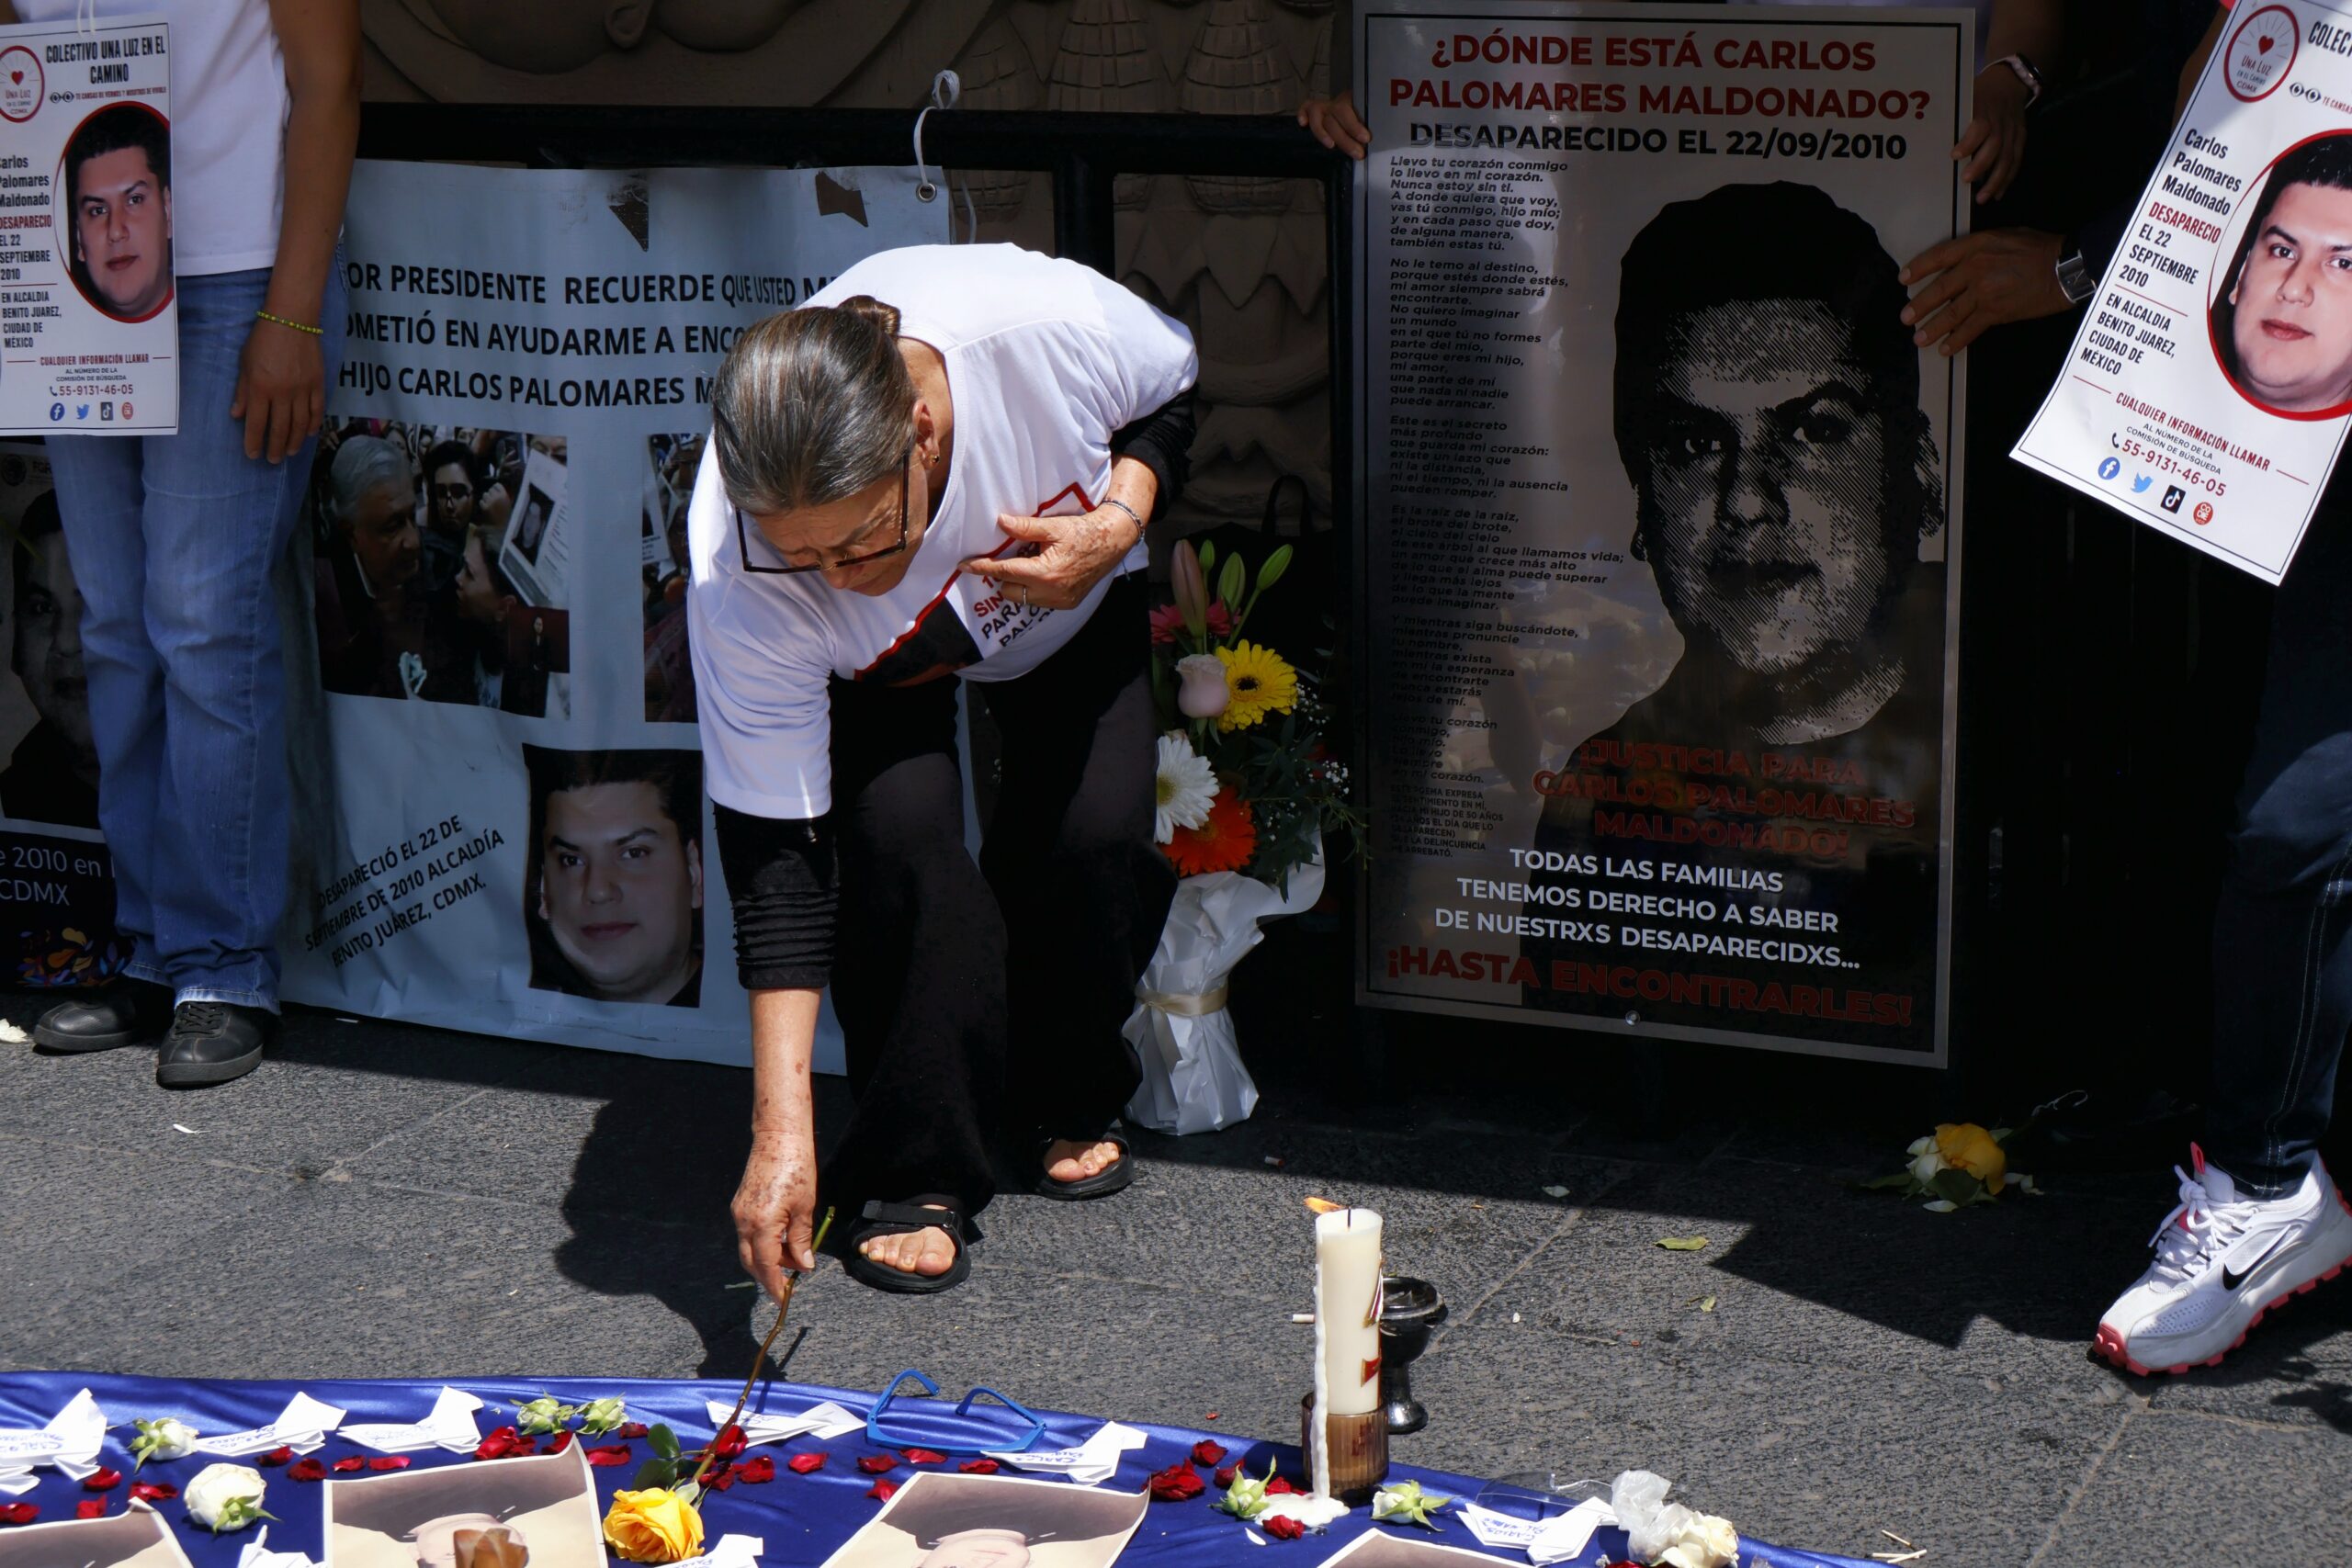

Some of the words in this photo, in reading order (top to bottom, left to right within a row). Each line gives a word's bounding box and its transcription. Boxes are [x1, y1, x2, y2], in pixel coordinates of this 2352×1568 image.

[46, 41, 98, 63] COLECTIVO
[101, 39, 121, 59] UNA
[123, 38, 140, 57] LUZ
[141, 37, 153, 55] EN
[155, 35, 165, 54] EL
[1431, 28, 1593, 68] ¿DÓNDE
[1606, 31, 1702, 68] ESTÁ
[1714, 39, 1876, 72] CARLOS
[2308, 20, 2352, 57] COLEC
[90, 63, 130, 84] CAMINO
[1390, 79, 1627, 113] PALOMARES
[1639, 85, 1930, 119] MALDONADO?
[1410, 123, 1668, 153] DESAPARECIDO
[1679, 130, 1716, 154] EL
[1726, 128, 1907, 160] 22/09/2010
[2184, 128, 2229, 159] Carlos
[0, 154, 28, 169] arlos
[1390, 156, 1427, 167] Llevo
[1431, 157, 1445, 167] tu
[1449, 158, 1503, 169] corazón
[1508, 161, 1568, 173] conmigo
[1407, 169, 1440, 179] llevo
[1443, 172, 1460, 180] en
[1464, 171, 1482, 180] mi
[1485, 172, 1544, 182] corazón.
[2172, 151, 2242, 192] Palomares
[1390, 179, 1432, 190] Nunca
[1436, 181, 1474, 193] estoy
[1477, 182, 1497, 192] sin
[1390, 191, 1401, 200] A
[1406, 191, 1449, 202] donde
[1453, 193, 1496, 205] quiera
[1499, 196, 1525, 207] que
[2161, 175, 2231, 216] Maldonado
[1391, 204, 1412, 213] vas
[1416, 203, 1430, 213] tú
[1500, 207, 1527, 219] hijo
[2148, 201, 2222, 243] DESAPARECIO
[10, 234, 21, 246] 22
[2138, 223, 2154, 242] EL
[2154, 230, 2172, 248] 22
[0, 250, 51, 264] SEPTIEMBRE
[0, 268, 20, 280] 2010
[2129, 243, 2199, 285] SEPTIEMBRE
[390, 265, 547, 304] PRESIDENTE
[565, 275, 715, 304] RECUERDE
[722, 275, 753, 309] QUE
[754, 276, 797, 306] USTED
[2119, 265, 2150, 288] 2010
[2, 292, 12, 303] EN
[14, 291, 50, 302] ALCALDIA
[2, 307, 29, 319] BENITO
[2106, 292, 2122, 310] EN
[2120, 300, 2171, 332] ALCALDIA
[3, 322, 31, 333] CIUDAD
[33, 321, 43, 333] DE
[5, 336, 34, 348] MÉXICO
[446, 319, 480, 348] EN
[487, 323, 647, 355] AYUDARME
[654, 326, 675, 354] A
[2097, 310, 2136, 337] BENITO
[2135, 329, 2176, 358] JUAREZ,
[40, 355, 76, 366] CUALQUIER
[79, 354, 123, 365] INFORMACIÓN
[125, 354, 149, 364] LLAMAR
[2080, 347, 2121, 375] MÉXICO
[2088, 330, 2128, 356] CIUDAD
[2128, 347, 2144, 364] DE
[59, 384, 133, 396] 55-9131-46-05
[340, 361, 391, 396] HIJO
[398, 367, 503, 400] CARLOS
[510, 376, 685, 407] PALOMARES
[2116, 392, 2166, 423] CUALQUIER
[2167, 415, 2229, 453] INFORMACIÓN
[2230, 444, 2270, 471] LLAMAR
[2143, 423, 2154, 432] AL
[2155, 429, 2190, 448] NÚMERO
[2191, 446, 2202, 455] DE
[2203, 451, 2213, 460] LA
[2122, 439, 2227, 496] 55-9131-46-05
[2126, 426, 2165, 449] COMISIÓN
[2166, 445, 2177, 455] DE
[2179, 449, 2222, 475] BÚSQUEDA
[1580, 739, 1754, 779] ¡JUSTICIA
[1760, 752, 1868, 786] PARA
[1532, 770, 1681, 808] CARLOS
[1685, 782, 1917, 829] PALOMARES
[1594, 809, 1849, 860] MALDONADO!
[12, 846, 68, 873] 2010
[74, 858, 102, 878] en
[318, 845, 399, 910] DESAPARECIÓ
[400, 840, 418, 862] EL
[419, 828, 438, 852] 22
[439, 815, 463, 840] DE
[1510, 848, 1599, 875] TODAS
[1605, 857, 1654, 881] LAS
[1661, 862, 1784, 893] FAMILIAS
[0, 878, 71, 907] CDMX
[304, 900, 368, 952] SEPTIEMBRE
[367, 889, 390, 912] DE
[390, 869, 424, 901] 2010
[427, 828, 504, 881] ALCALDÍA
[1456, 877, 1582, 908] TENEMOS
[1589, 889, 1716, 921] DERECHO
[1723, 903, 1744, 924] A
[1749, 906, 1838, 933] SABER
[332, 931, 373, 968] BENITO
[375, 902, 433, 947] JUÁREZ,
[433, 873, 487, 910] CDMX.
[1435, 908, 1470, 930] DE
[1477, 912, 1611, 944] NUESTRXS
[1622, 926, 1860, 970] DESAPARECIDXS...
[1388, 945, 1542, 989] ¡HASTA
[1551, 959, 1913, 1027] ENCONTRARLES!
